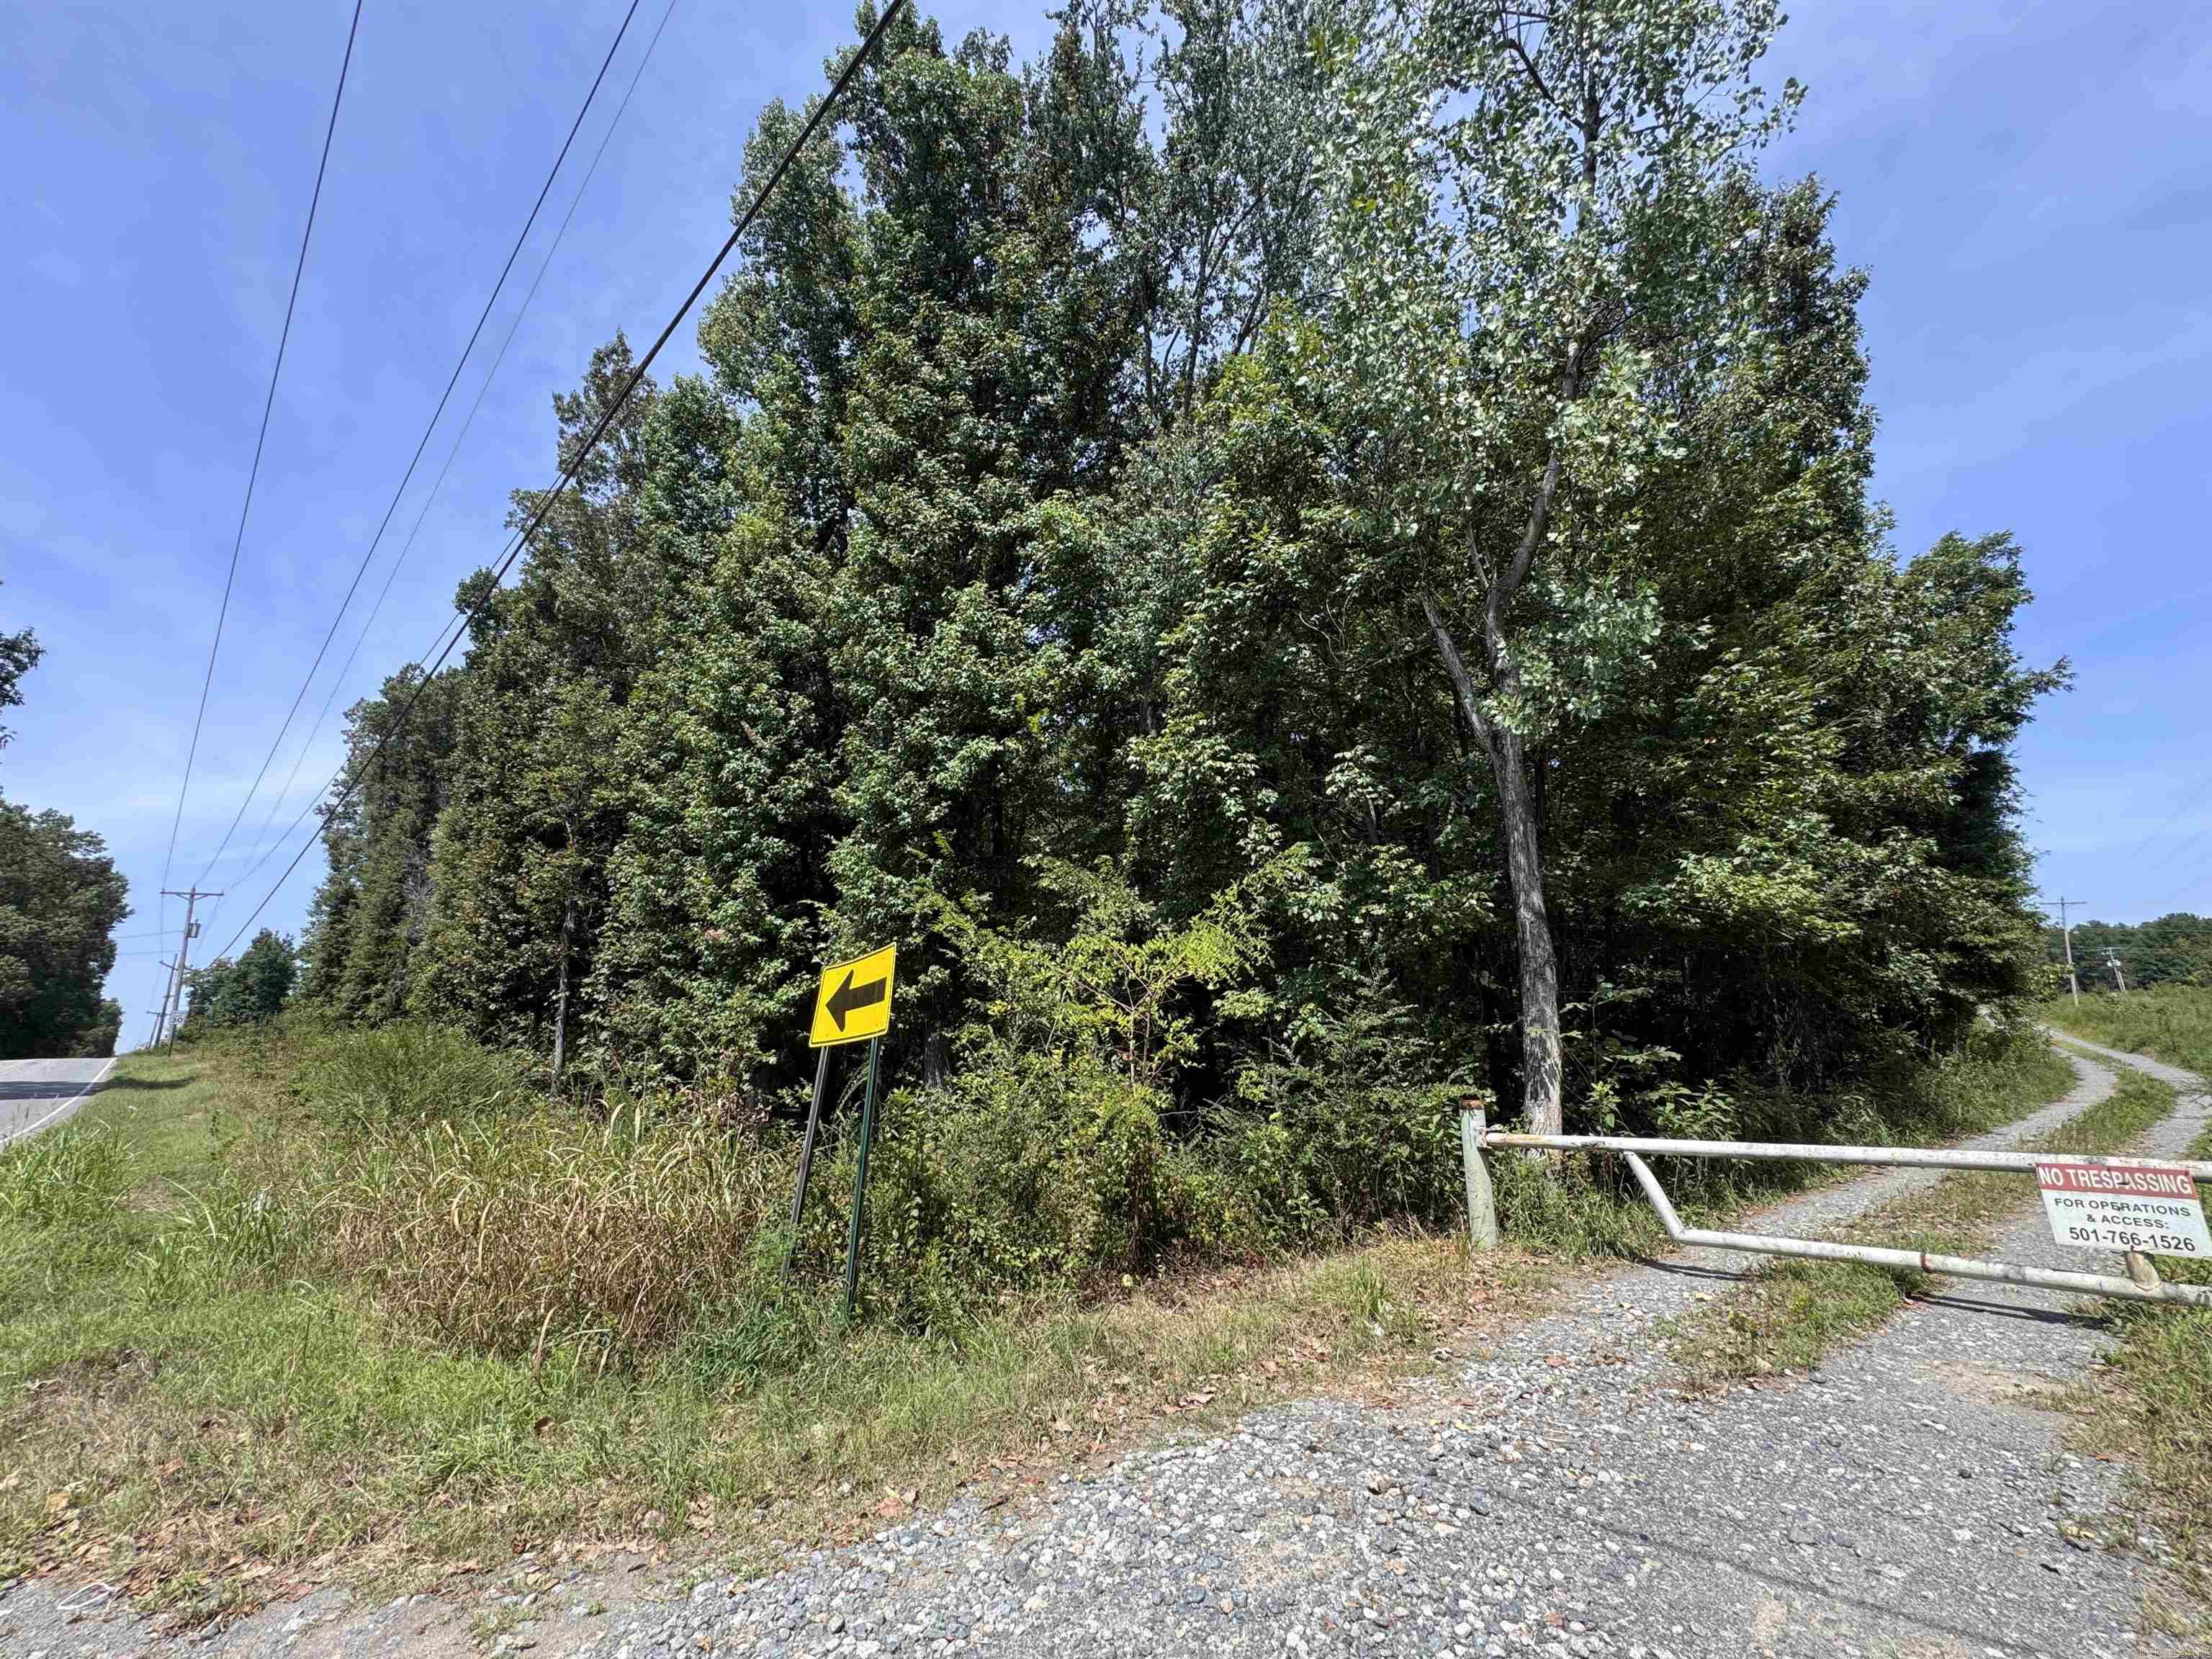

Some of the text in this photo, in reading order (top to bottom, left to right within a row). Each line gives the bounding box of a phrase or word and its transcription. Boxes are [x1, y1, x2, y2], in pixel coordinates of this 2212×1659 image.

[2038, 1166, 2193, 1195] NO TRESPASSING
[2054, 1197, 2191, 1217] FOR OPERATIONS
[2086, 1214, 2170, 1229] & ACCESS:
[2069, 1227, 2196, 1251] 501-766-1526
